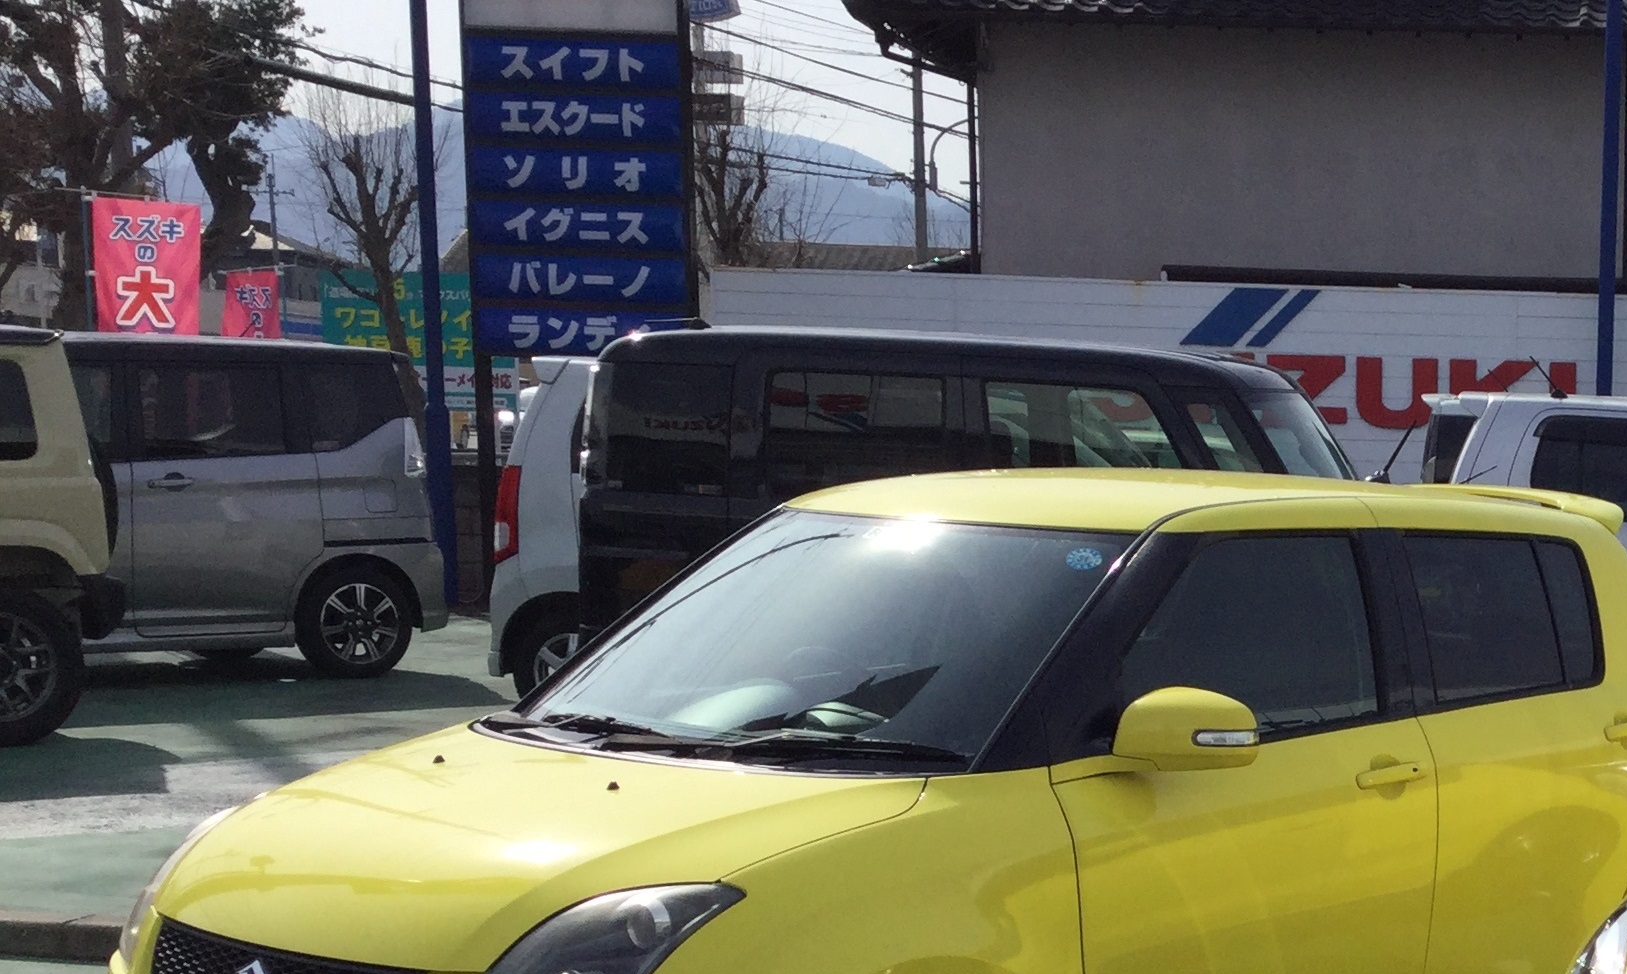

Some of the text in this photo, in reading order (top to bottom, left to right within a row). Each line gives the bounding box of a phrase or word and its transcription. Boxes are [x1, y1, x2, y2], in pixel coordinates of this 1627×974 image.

[500, 45, 645, 82] スイフト
[501, 100, 646, 138] エスクード
[503, 154, 647, 192] ソリオ
[109, 215, 184, 243] スズキ
[504, 207, 649, 245] イグニス
[135, 243, 156, 262] の
[116, 266, 175, 328] 大
[508, 260, 650, 297] バレーノ
[508, 315, 650, 350] ランデ
